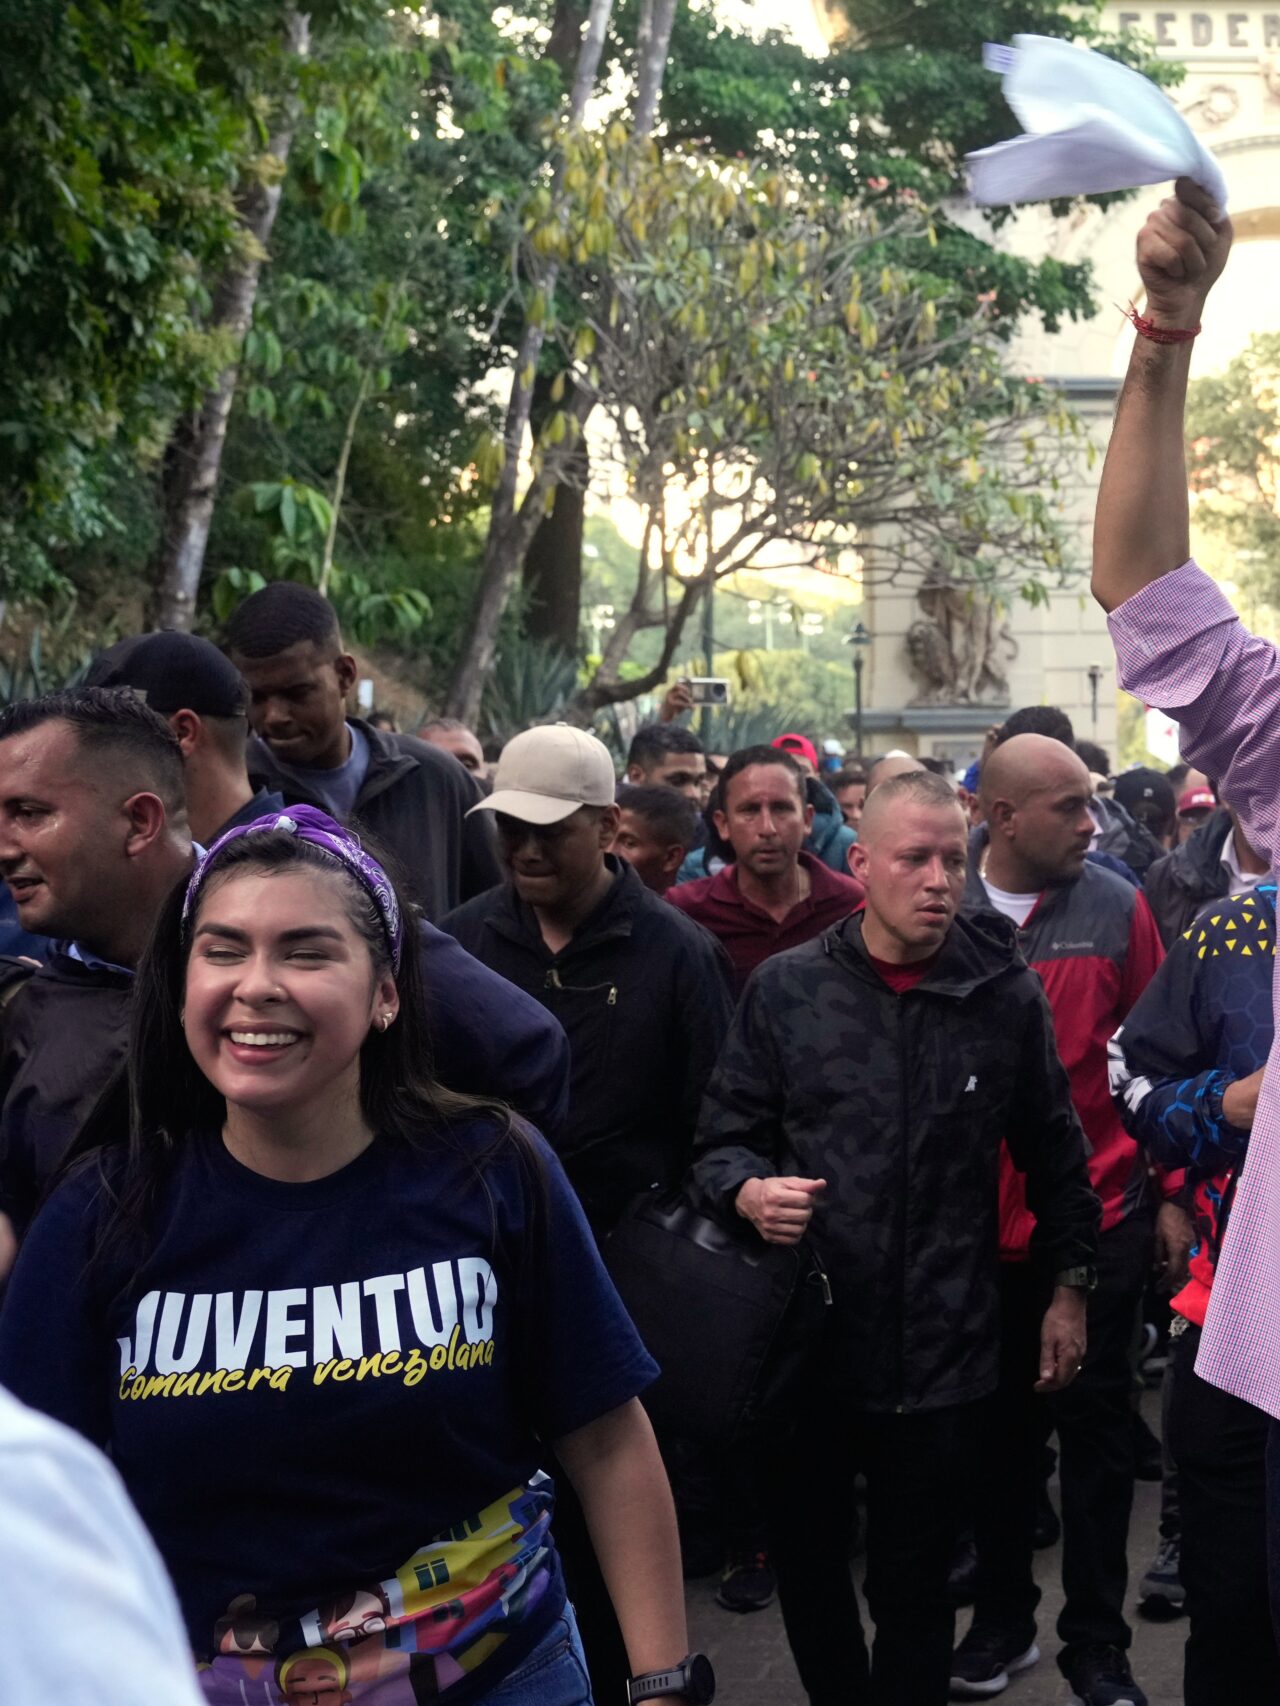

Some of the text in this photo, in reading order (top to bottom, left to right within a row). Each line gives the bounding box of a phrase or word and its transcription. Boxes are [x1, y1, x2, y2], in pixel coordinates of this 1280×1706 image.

[116, 1257, 498, 1379] JUVENTUD
[119, 1324, 495, 1400] Comunera venezolana
